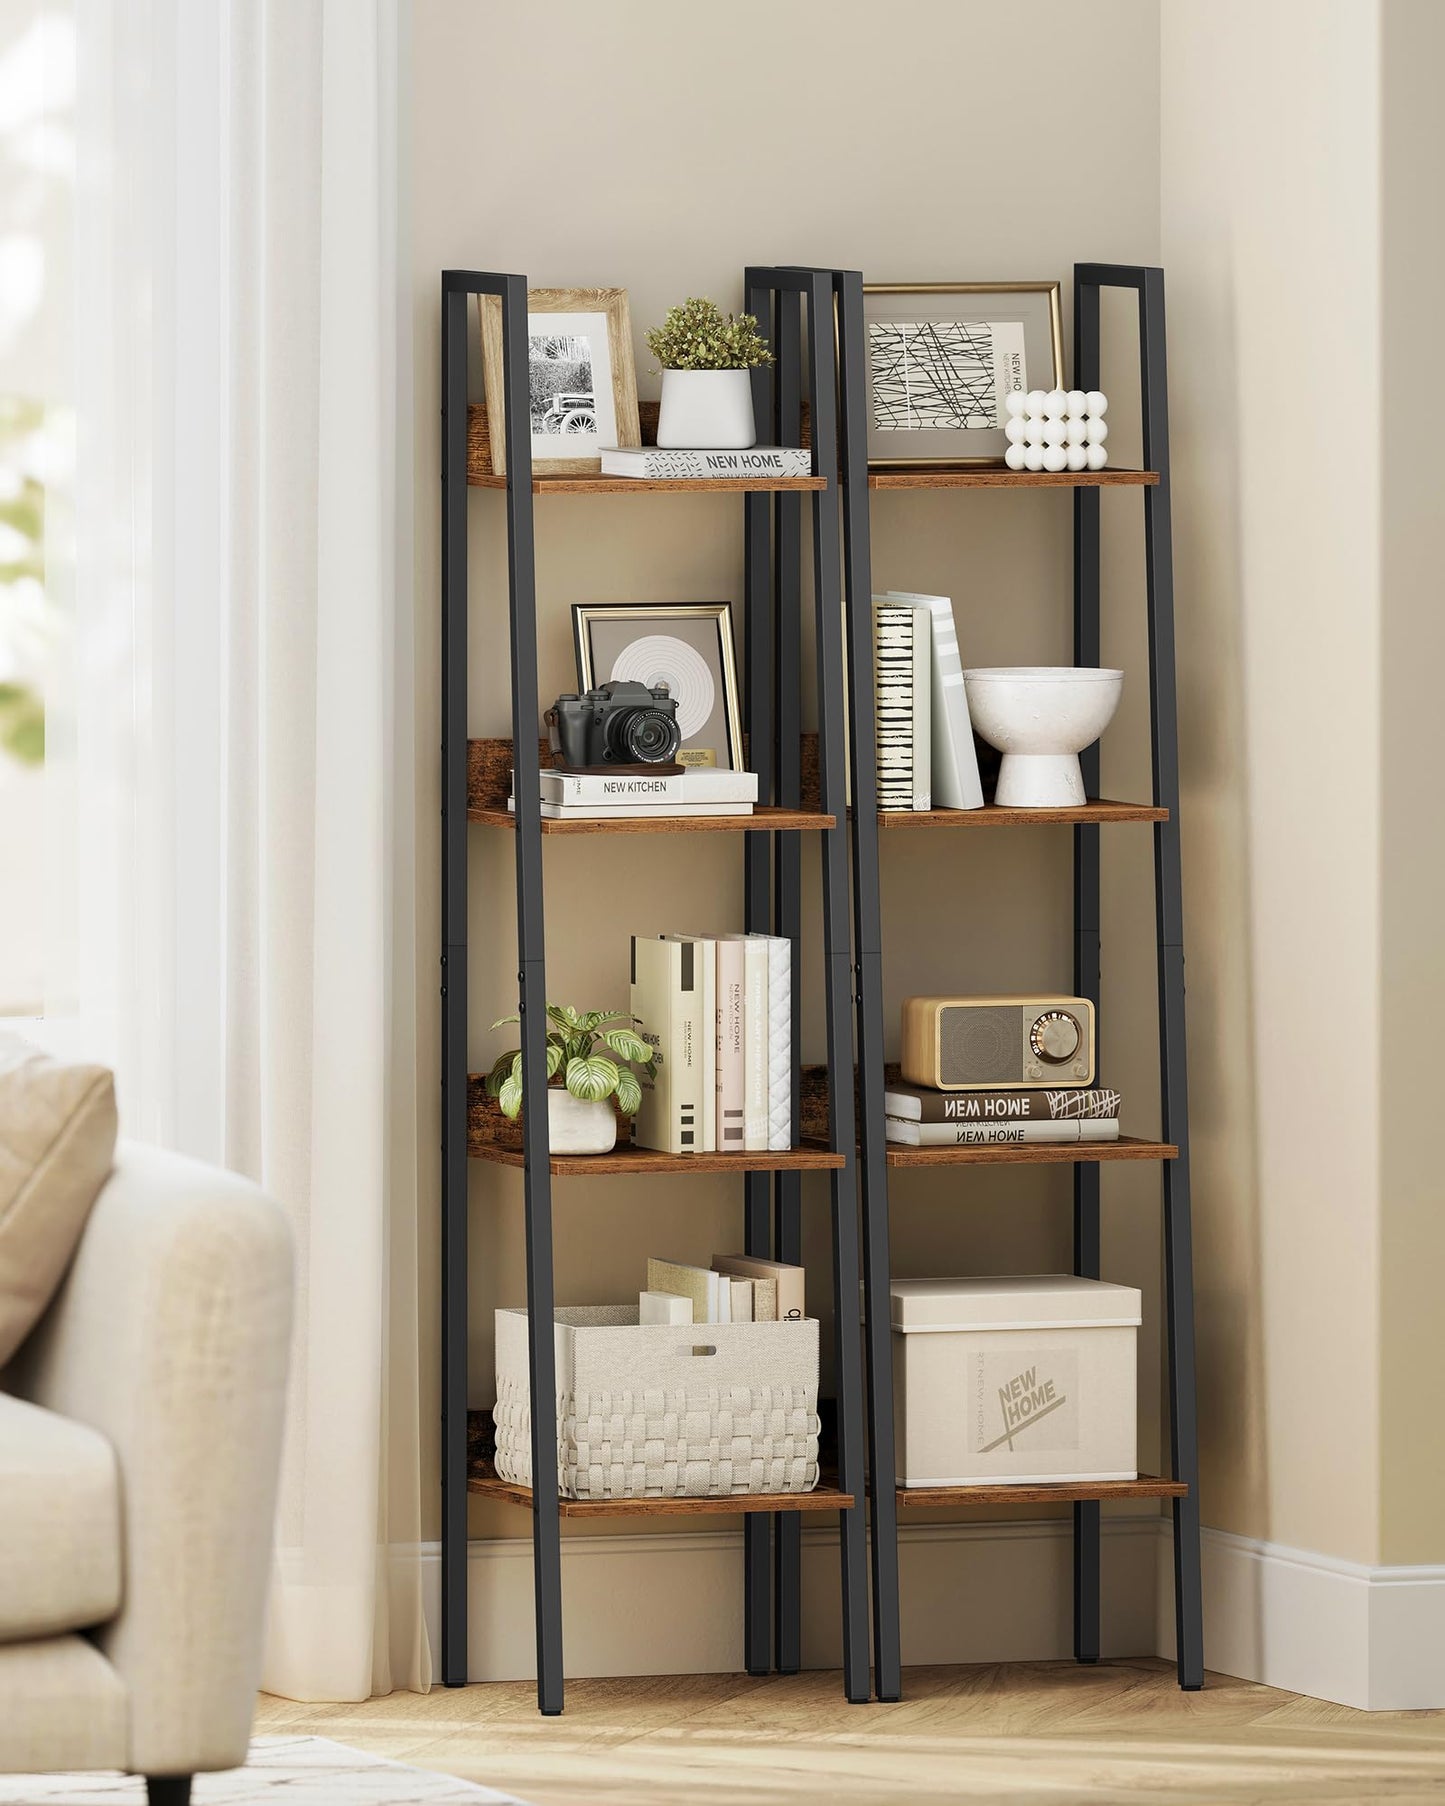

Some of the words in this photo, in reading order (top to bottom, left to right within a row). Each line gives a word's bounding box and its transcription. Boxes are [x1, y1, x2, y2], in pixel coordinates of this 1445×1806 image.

[1011, 353, 1021, 376] NEW
[1013, 377, 1022, 391] HO
[706, 455, 737, 469] NEW
[741, 454, 783, 468] HOME
[603, 781, 626, 793] NEW
[627, 780, 667, 792] KITCHEN
[976, 1368, 985, 1400] NEW
[1007, 1378, 1056, 1426] HOME
[976, 1403, 985, 1445] HOME
